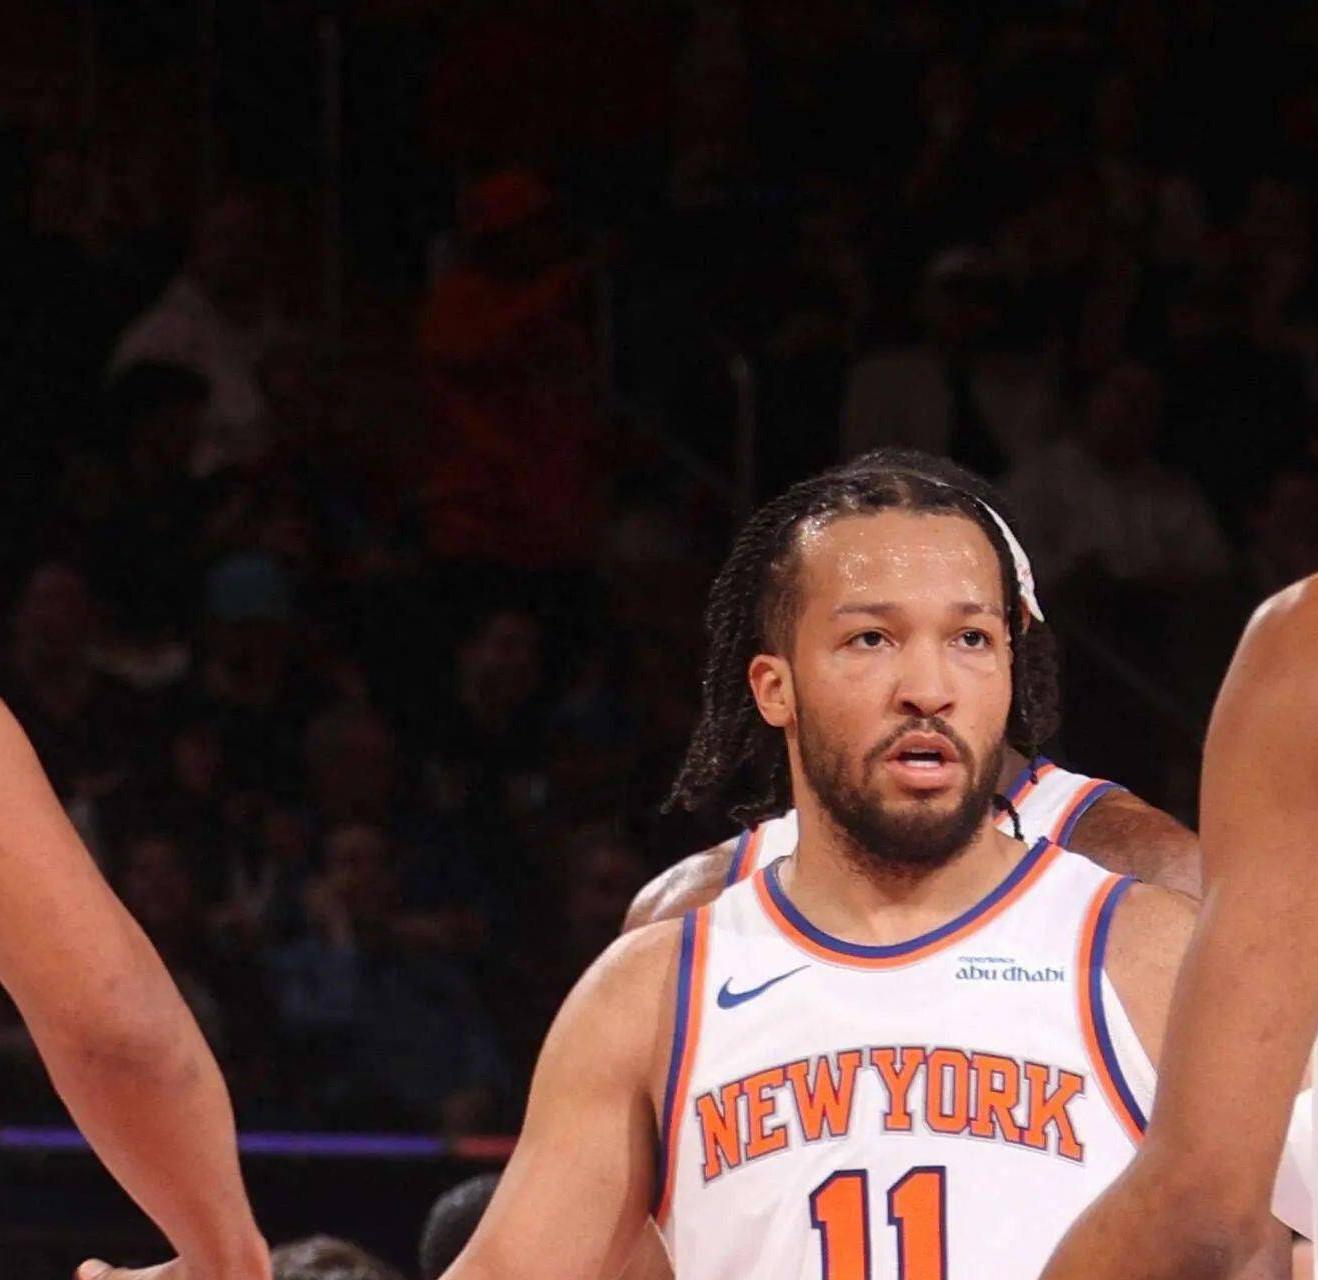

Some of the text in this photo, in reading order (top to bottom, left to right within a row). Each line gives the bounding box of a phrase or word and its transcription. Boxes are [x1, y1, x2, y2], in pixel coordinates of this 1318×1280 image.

[955, 965, 1066, 982] abu dhabi
[695, 1045, 1086, 1186] NEW YORK
